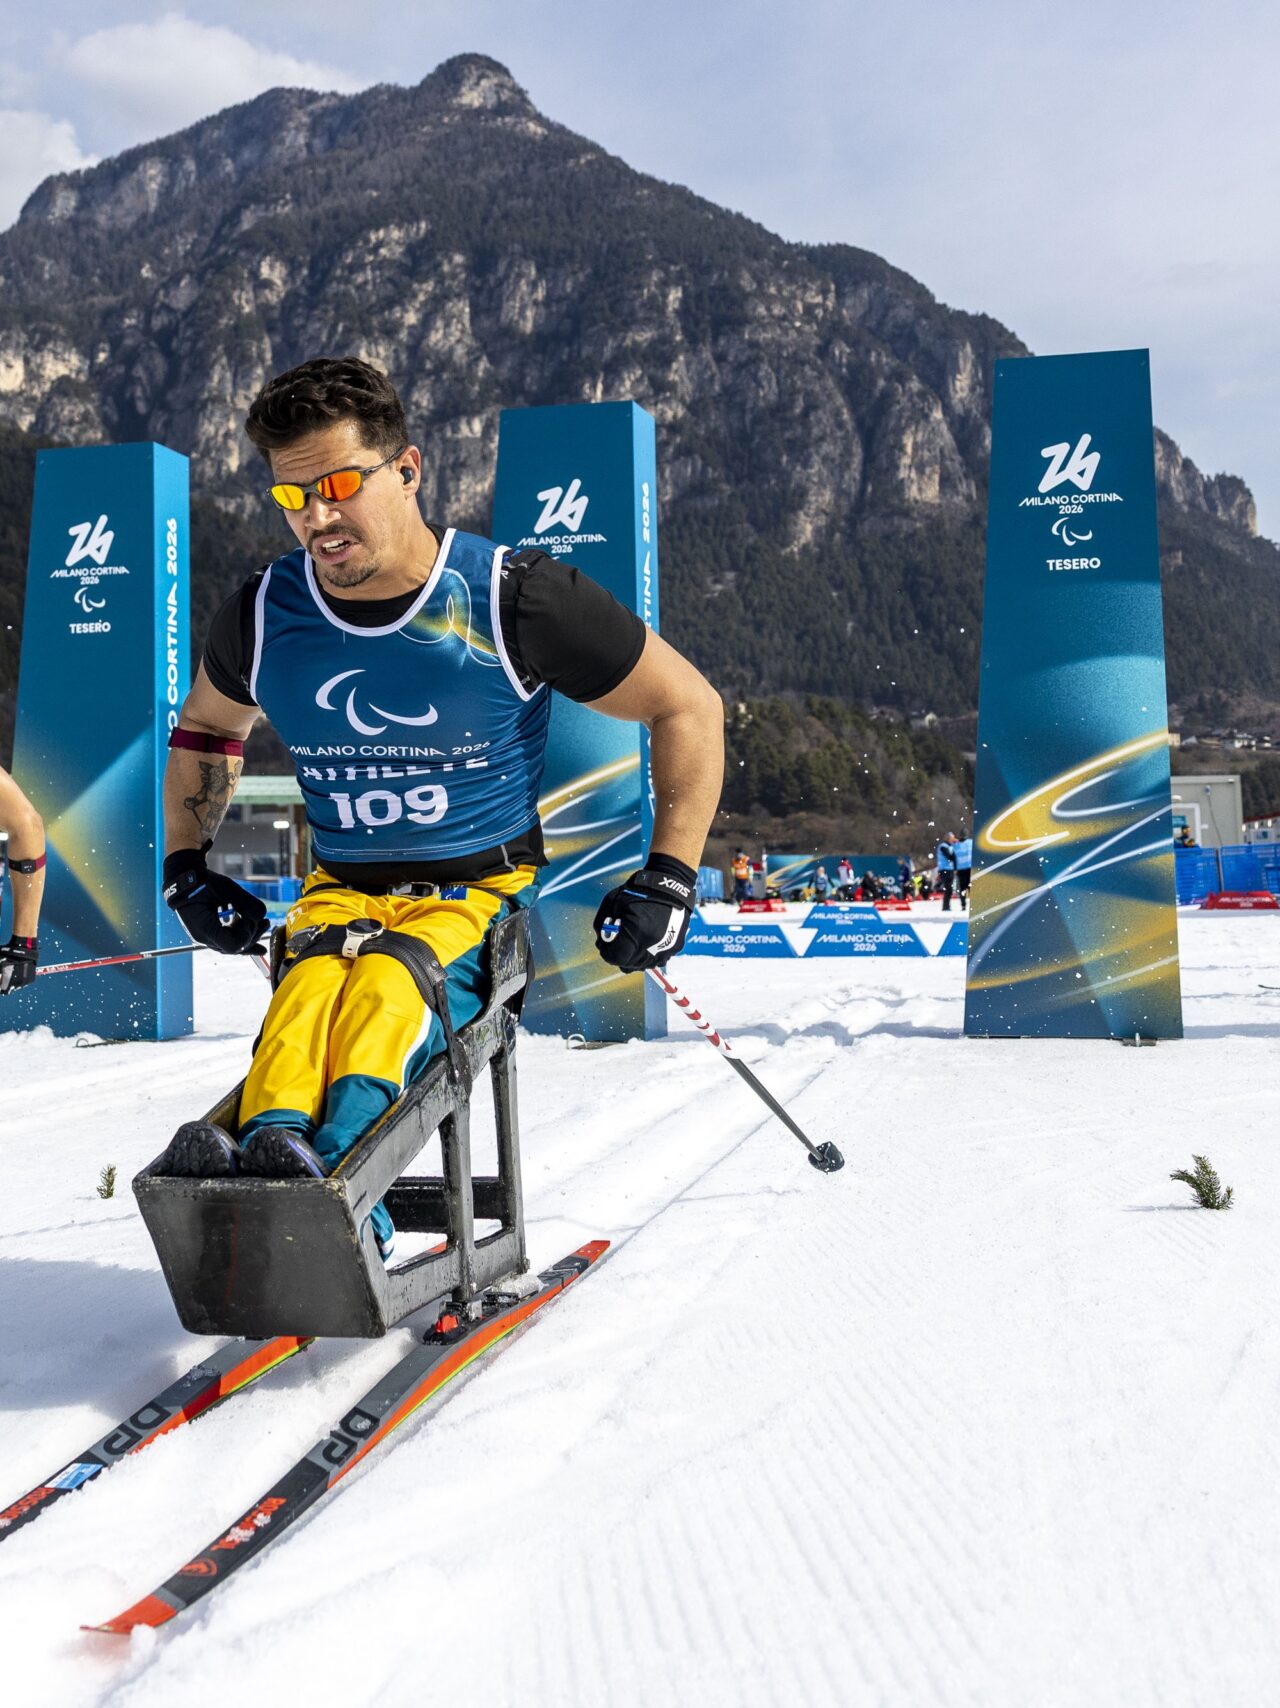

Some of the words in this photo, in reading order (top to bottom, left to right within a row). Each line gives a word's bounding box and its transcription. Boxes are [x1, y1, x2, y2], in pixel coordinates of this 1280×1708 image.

[1019, 495, 1069, 507] MILANO
[1070, 492, 1123, 504] CORTINA
[641, 481, 651, 544] 2026
[1058, 504, 1084, 514] 2026
[166, 517, 178, 576] 2026
[517, 535, 560, 547] MILANO
[561, 533, 607, 544] CORTINA
[551, 544, 573, 554] 2026
[1046, 557, 1101, 571] TESERO
[50, 567, 89, 578] MILANO
[90, 566, 130, 576] CORTINA
[80, 577, 99, 585] 2026
[69, 621, 111, 634] TESERO
[167, 581, 178, 705] CORTINA
[289, 744, 356, 756] MILANO
[359, 744, 448, 757] CORTINA
[451, 740, 492, 756] 2026
[328, 783, 449, 829] 109
[658, 876, 691, 898] SWIX
[687, 934, 733, 944] MILANO
[734, 934, 783, 944] CORTINA
[816, 933, 864, 943] MILANO
[865, 932, 915, 943] CORTINA
[722, 943, 746, 954] 2026
[853, 942, 877, 952] 2026
